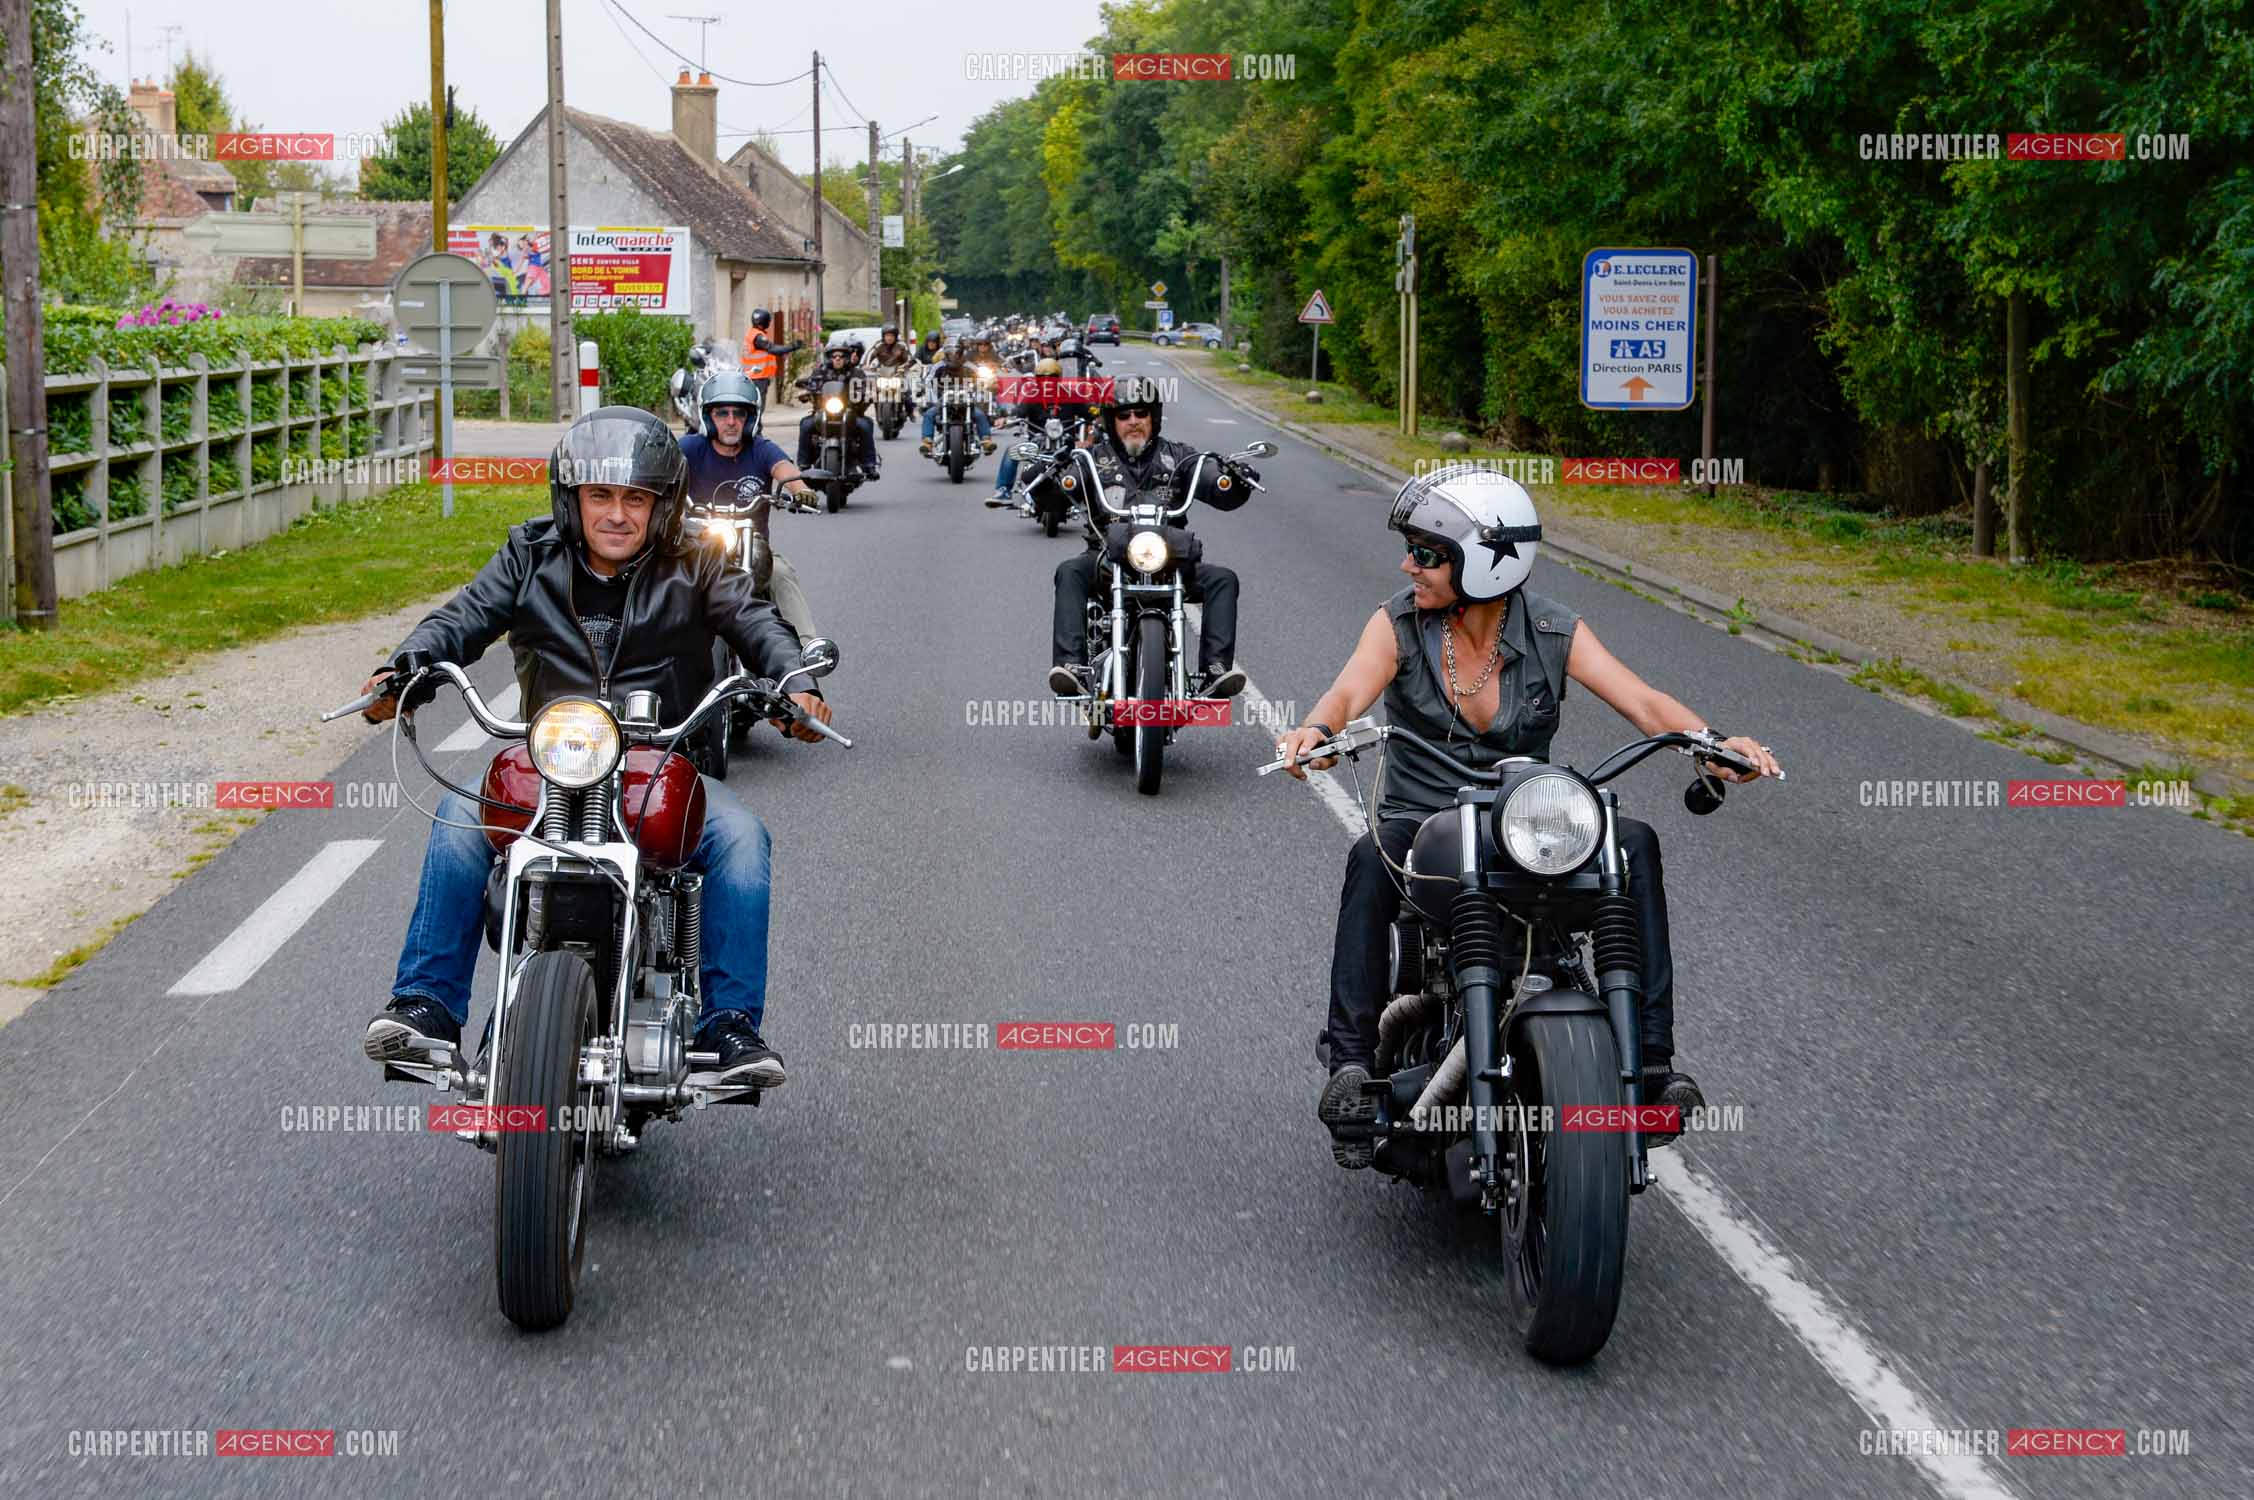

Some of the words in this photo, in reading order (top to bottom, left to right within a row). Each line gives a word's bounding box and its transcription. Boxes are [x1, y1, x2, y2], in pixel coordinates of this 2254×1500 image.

[1614, 264, 1687, 275] E.LECLERC
[1599, 295, 1625, 303] VOUS
[1628, 295, 1657, 303] SAVEZ
[1659, 295, 1680, 303] QUE
[1603, 306, 1629, 315] VOUS
[1631, 306, 1674, 315] ACHETEZ
[1591, 320, 1640, 331] MOINS
[1645, 320, 1687, 331] CHER
[1638, 341, 1663, 357] A5
[1592, 363, 1645, 373] Direction
[1647, 363, 1683, 373] PARIS
